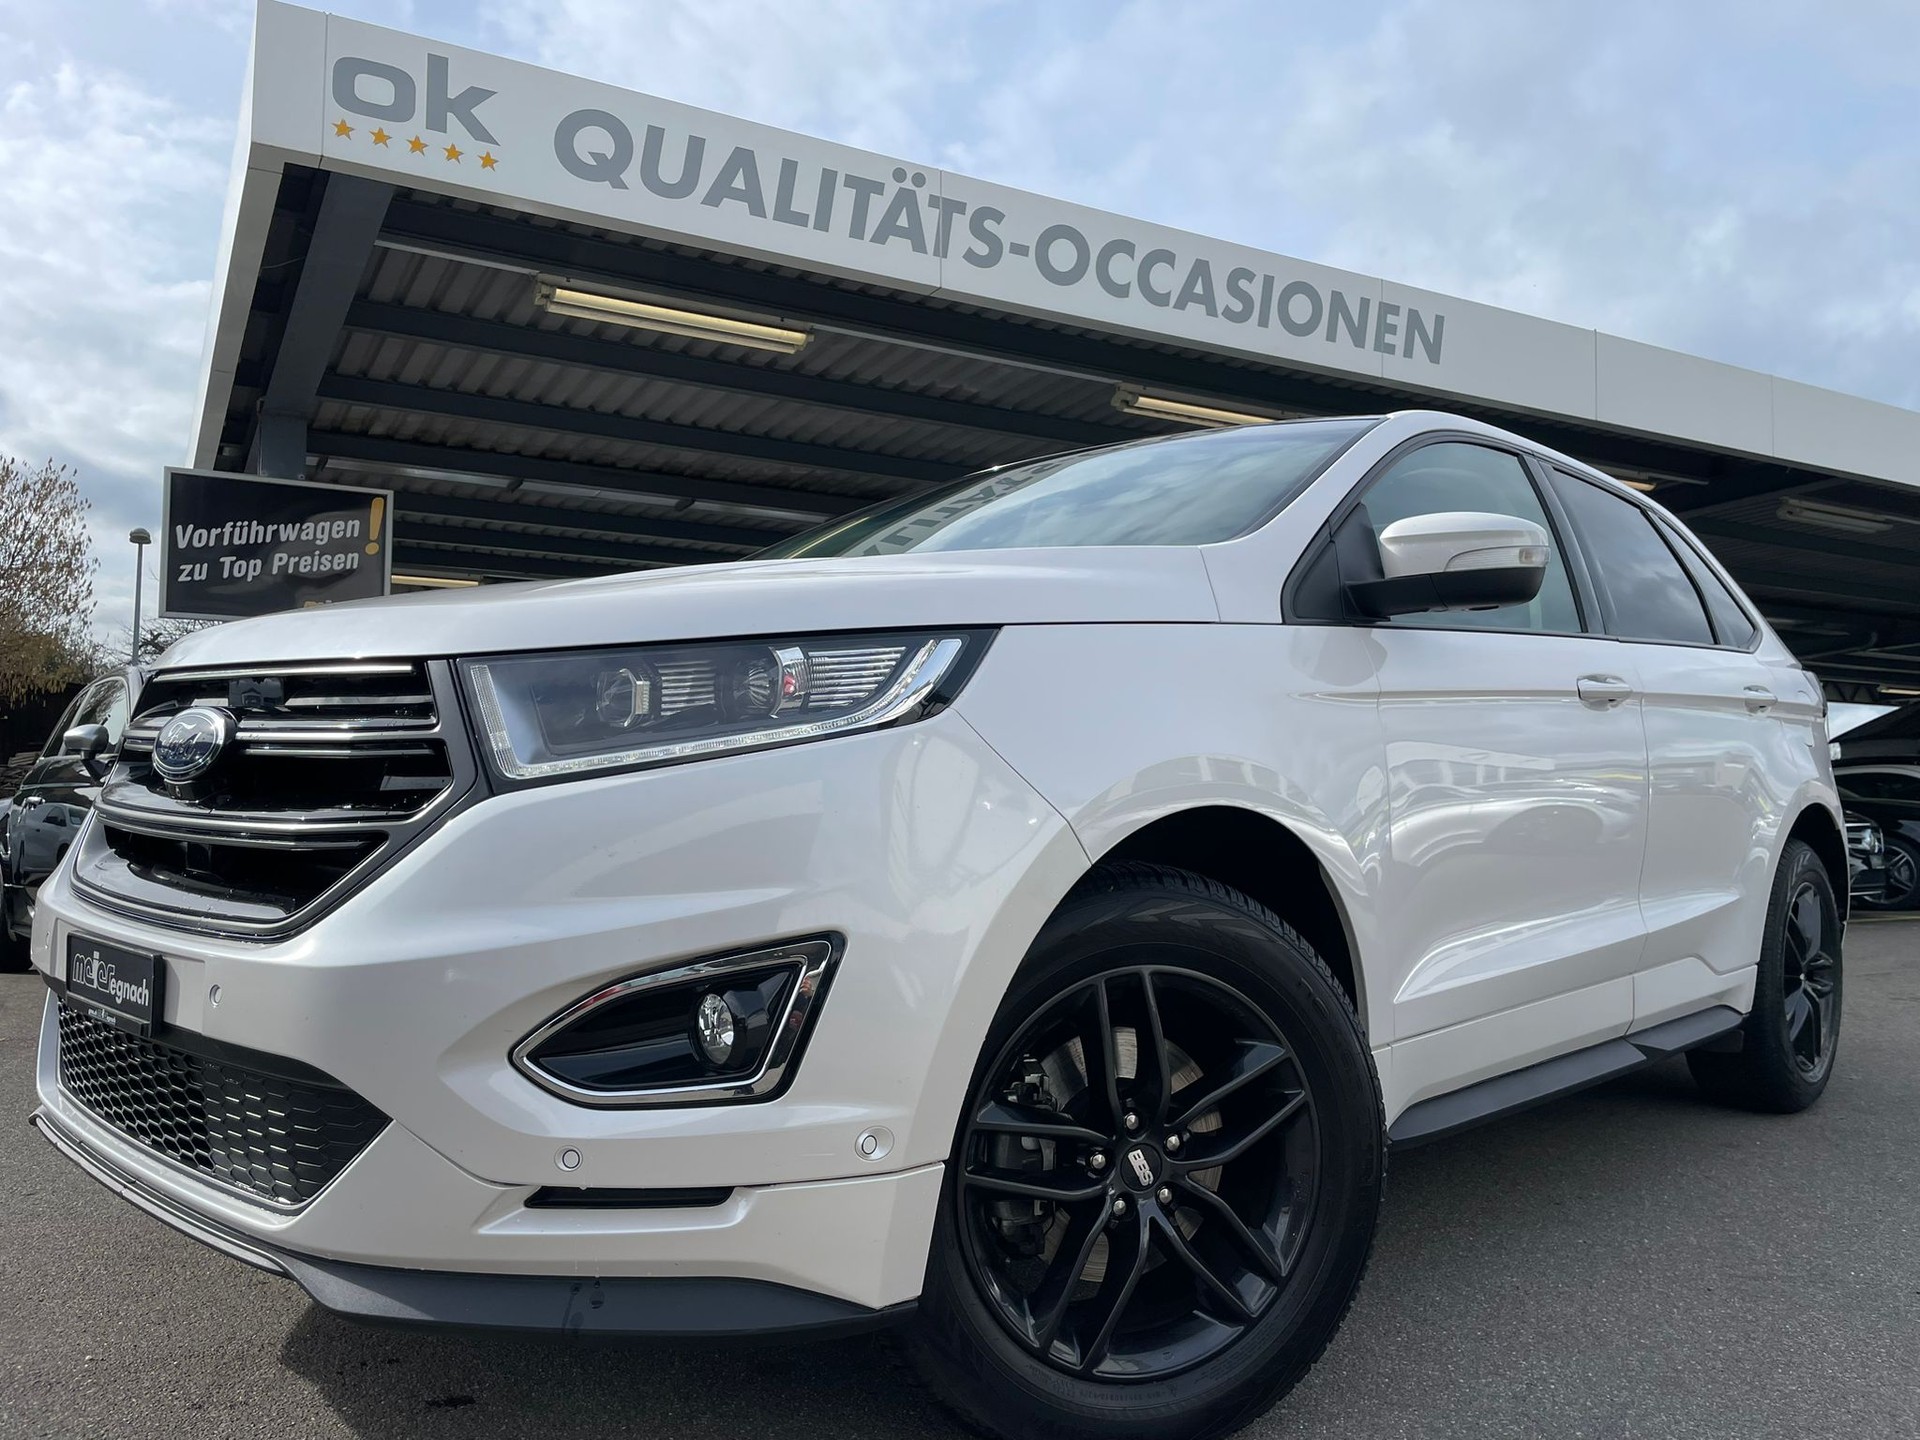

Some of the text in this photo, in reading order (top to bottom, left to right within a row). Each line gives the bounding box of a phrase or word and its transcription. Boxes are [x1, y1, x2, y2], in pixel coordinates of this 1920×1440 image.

[332, 52, 1445, 365] ok QUALITÄTS-OCCASIONEN
[175, 519, 361, 549] Vorführwagen
[177, 550, 359, 582] zu Top Preisen
[110, 978, 149, 1006] egnach
[1127, 1149, 1154, 1186] BBS
